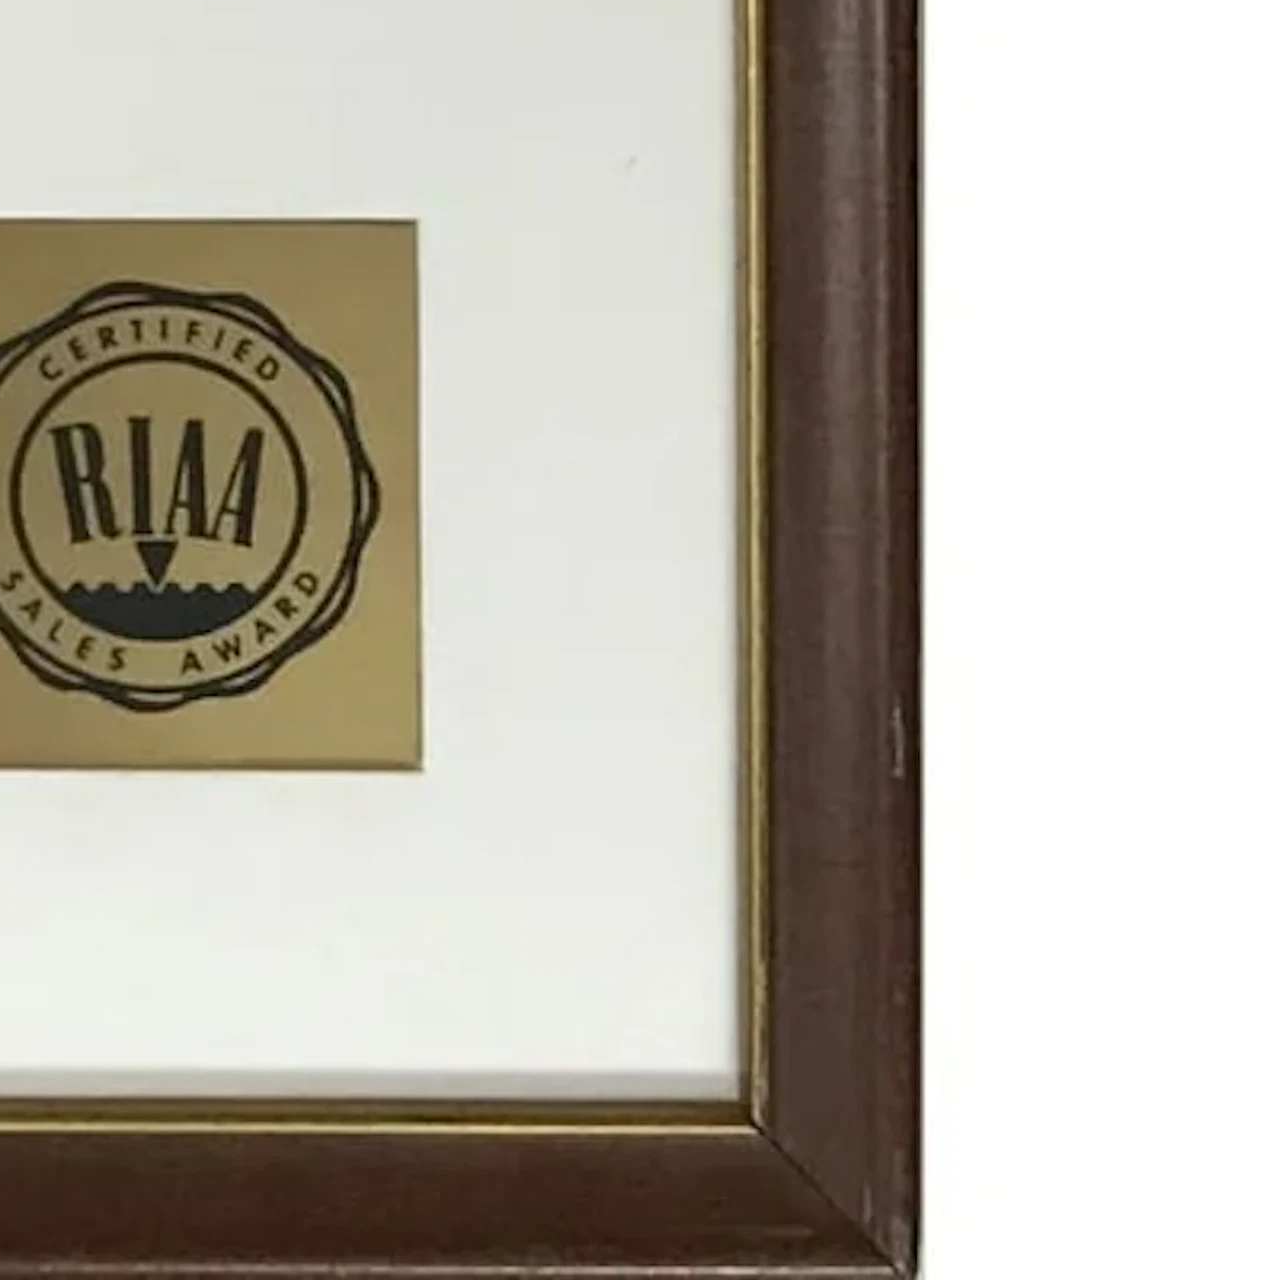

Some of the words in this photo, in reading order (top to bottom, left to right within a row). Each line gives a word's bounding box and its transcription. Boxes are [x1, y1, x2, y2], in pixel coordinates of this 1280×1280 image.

[39, 315, 282, 383] CERTIFIED
[48, 415, 266, 549] RIAA
[0, 569, 127, 672] SALES
[180, 570, 319, 675] AWARD
